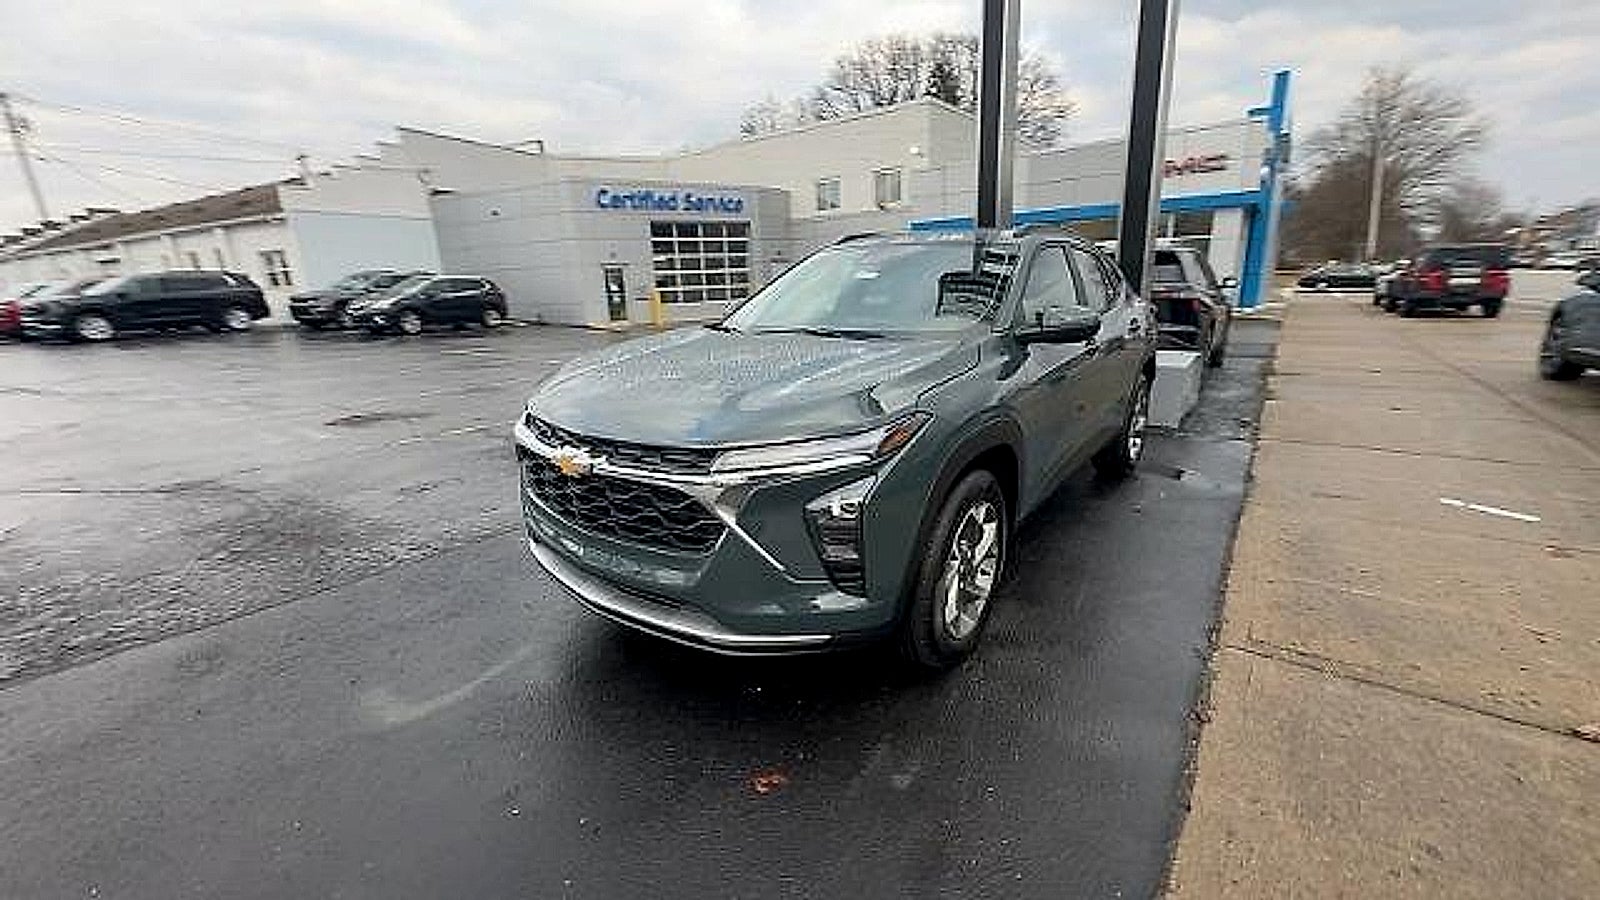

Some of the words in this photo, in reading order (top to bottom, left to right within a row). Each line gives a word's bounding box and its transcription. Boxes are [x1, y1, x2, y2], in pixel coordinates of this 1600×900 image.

[1163, 153, 1228, 178] MC
[597, 187, 678, 211] Certified
[680, 190, 745, 214] Service
